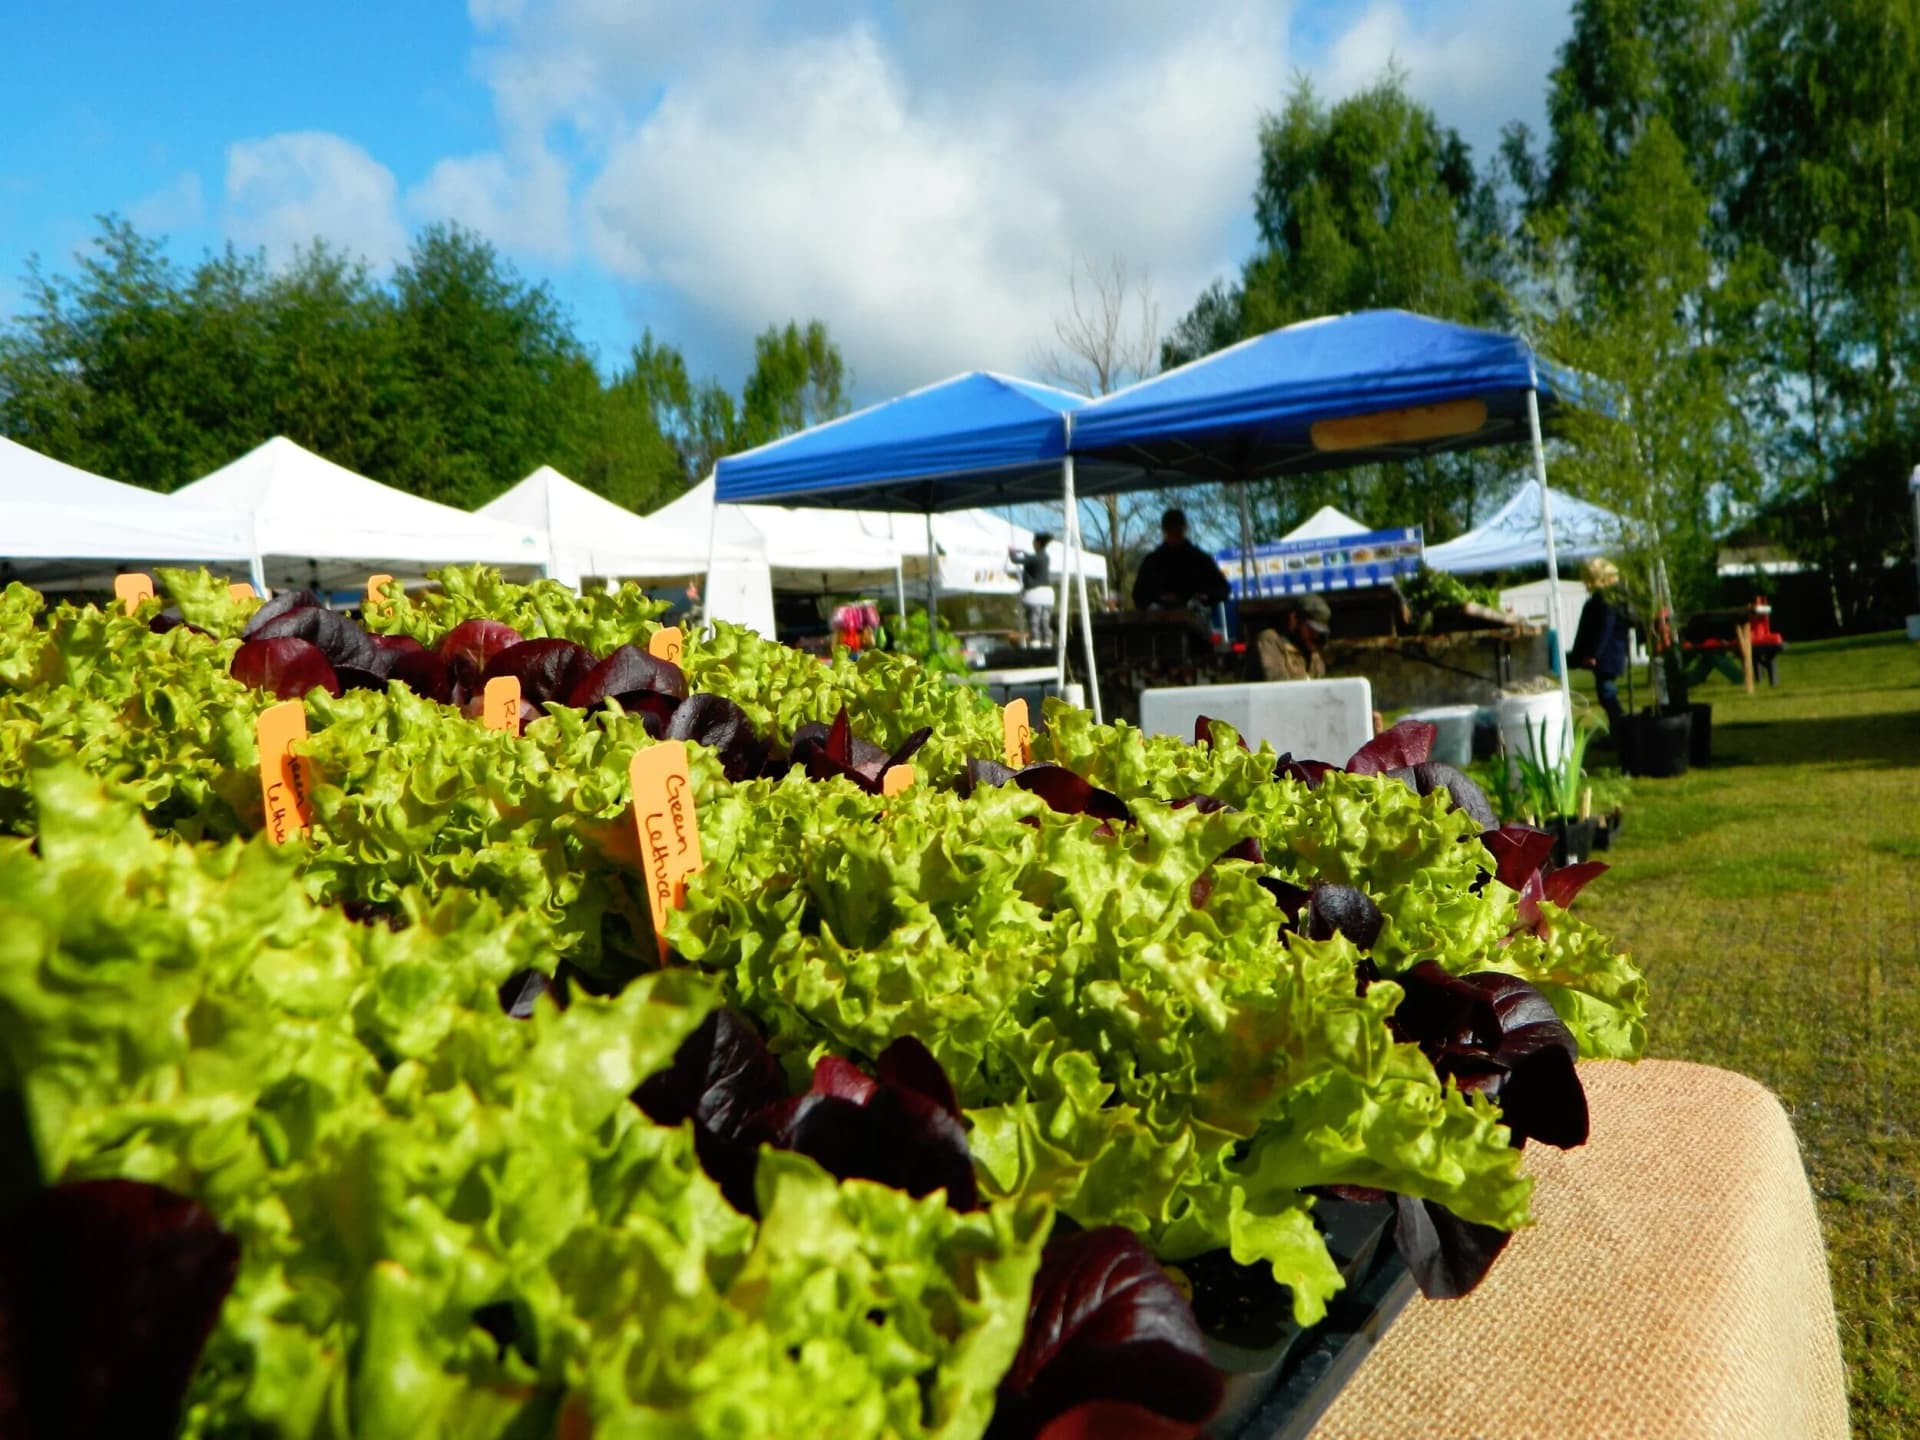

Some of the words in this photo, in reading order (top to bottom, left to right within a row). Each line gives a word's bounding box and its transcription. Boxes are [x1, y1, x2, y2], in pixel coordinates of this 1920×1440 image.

[266, 781, 287, 846] Lettuc
[665, 774, 688, 856] Green
[644, 813, 672, 913] Lettuce
